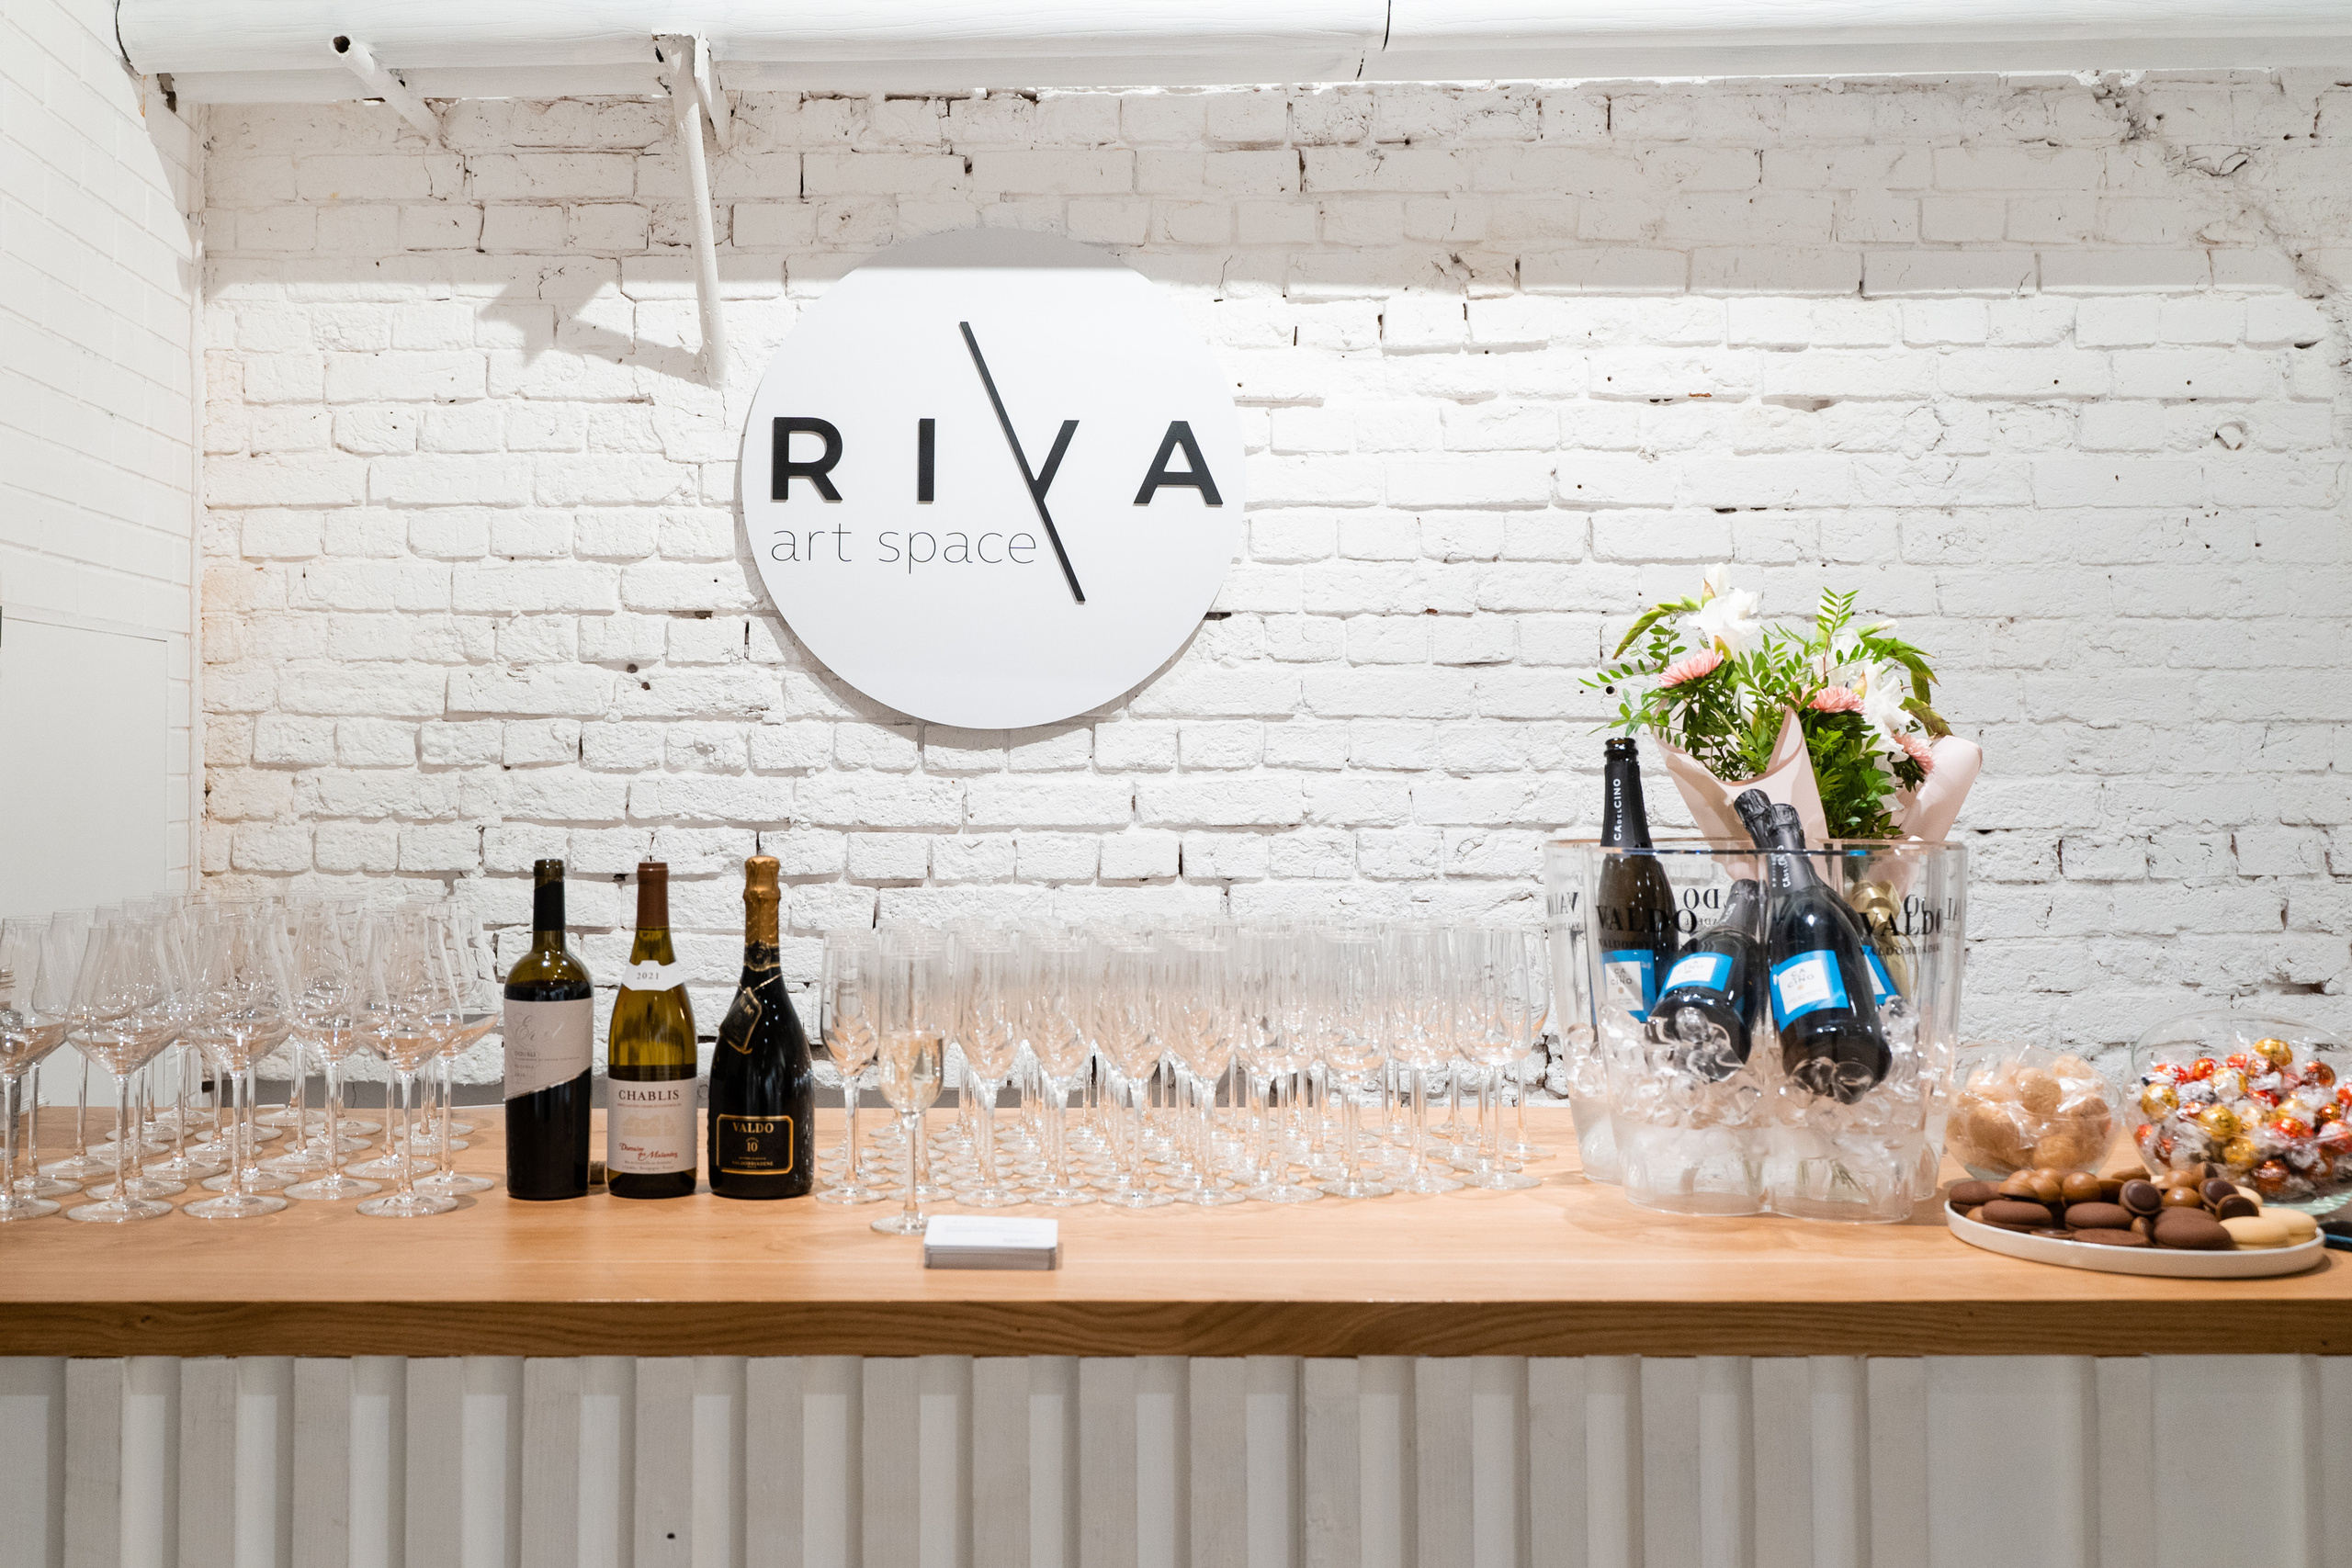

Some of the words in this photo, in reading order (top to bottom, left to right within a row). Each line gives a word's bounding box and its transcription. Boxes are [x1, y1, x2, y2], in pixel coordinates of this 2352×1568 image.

[770, 523, 852, 563] art
[877, 530, 1037, 574] space
[1596, 904, 1698, 934] VALDO
[636, 972, 660, 980] 2021
[618, 1089, 680, 1101] CHABLIS
[732, 1122, 775, 1134] VALDO
[746, 1142, 758, 1153] 10
